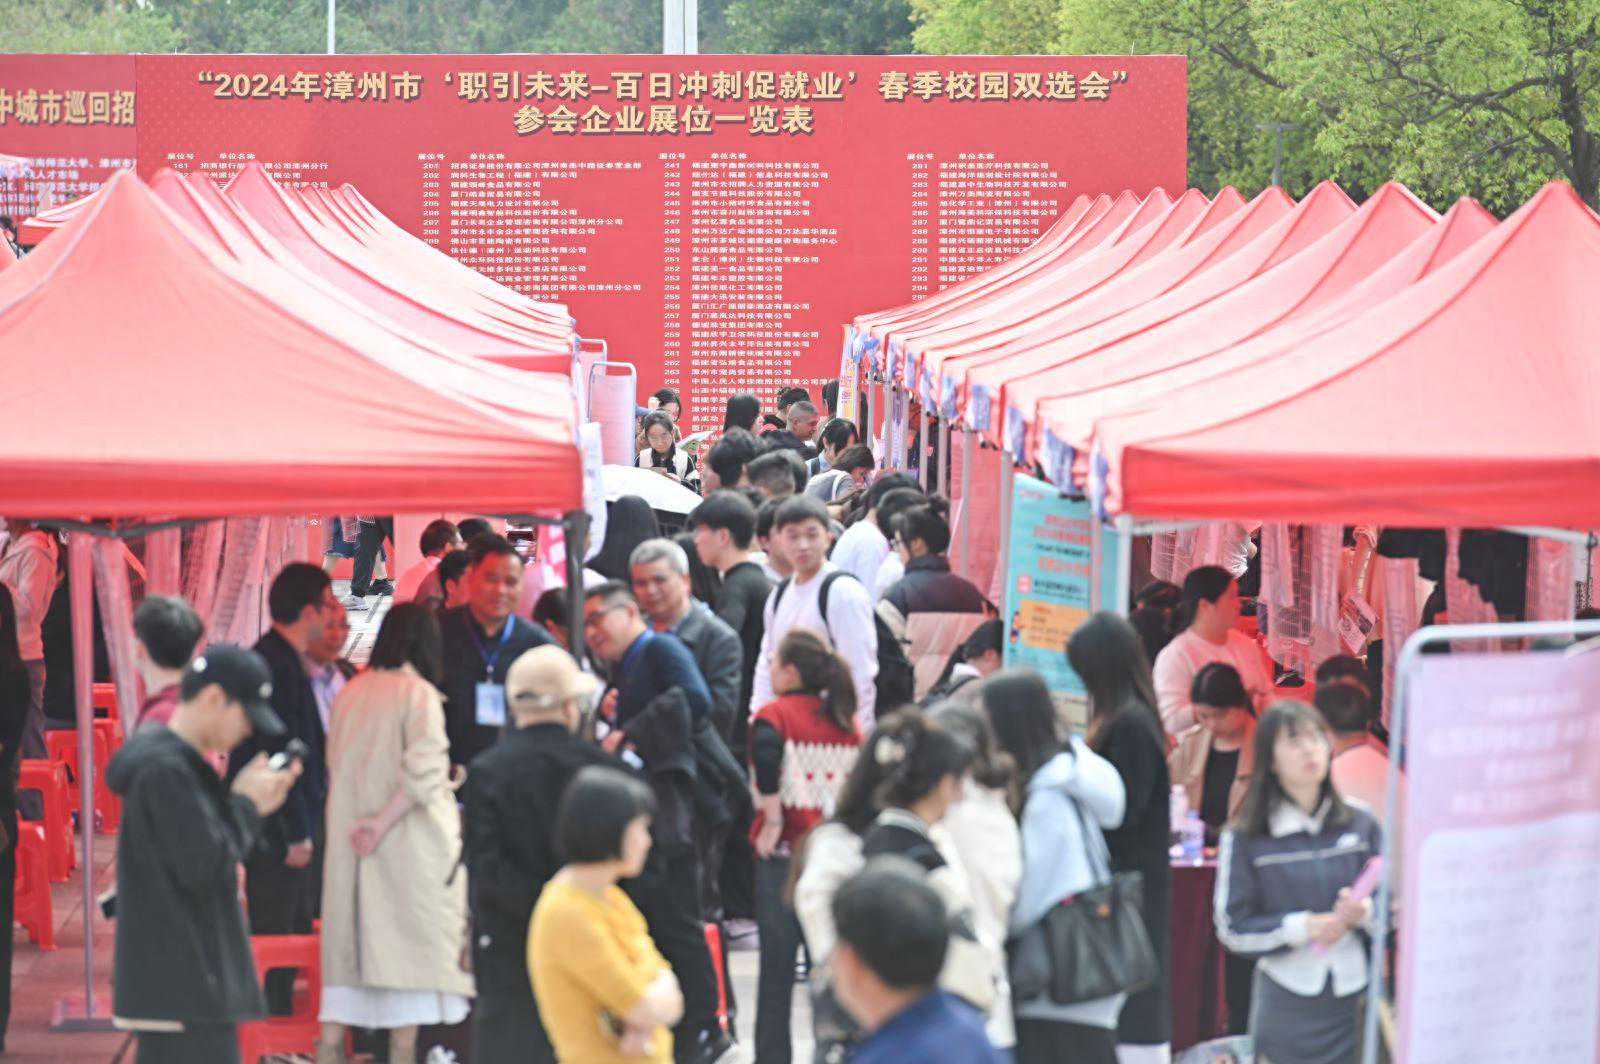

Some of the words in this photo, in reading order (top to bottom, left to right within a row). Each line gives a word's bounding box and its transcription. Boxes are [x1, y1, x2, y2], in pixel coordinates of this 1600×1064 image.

[879, 70, 1129, 102] 春季校园双选会”
[514, 105, 815, 137] 参会企业展位一览表
